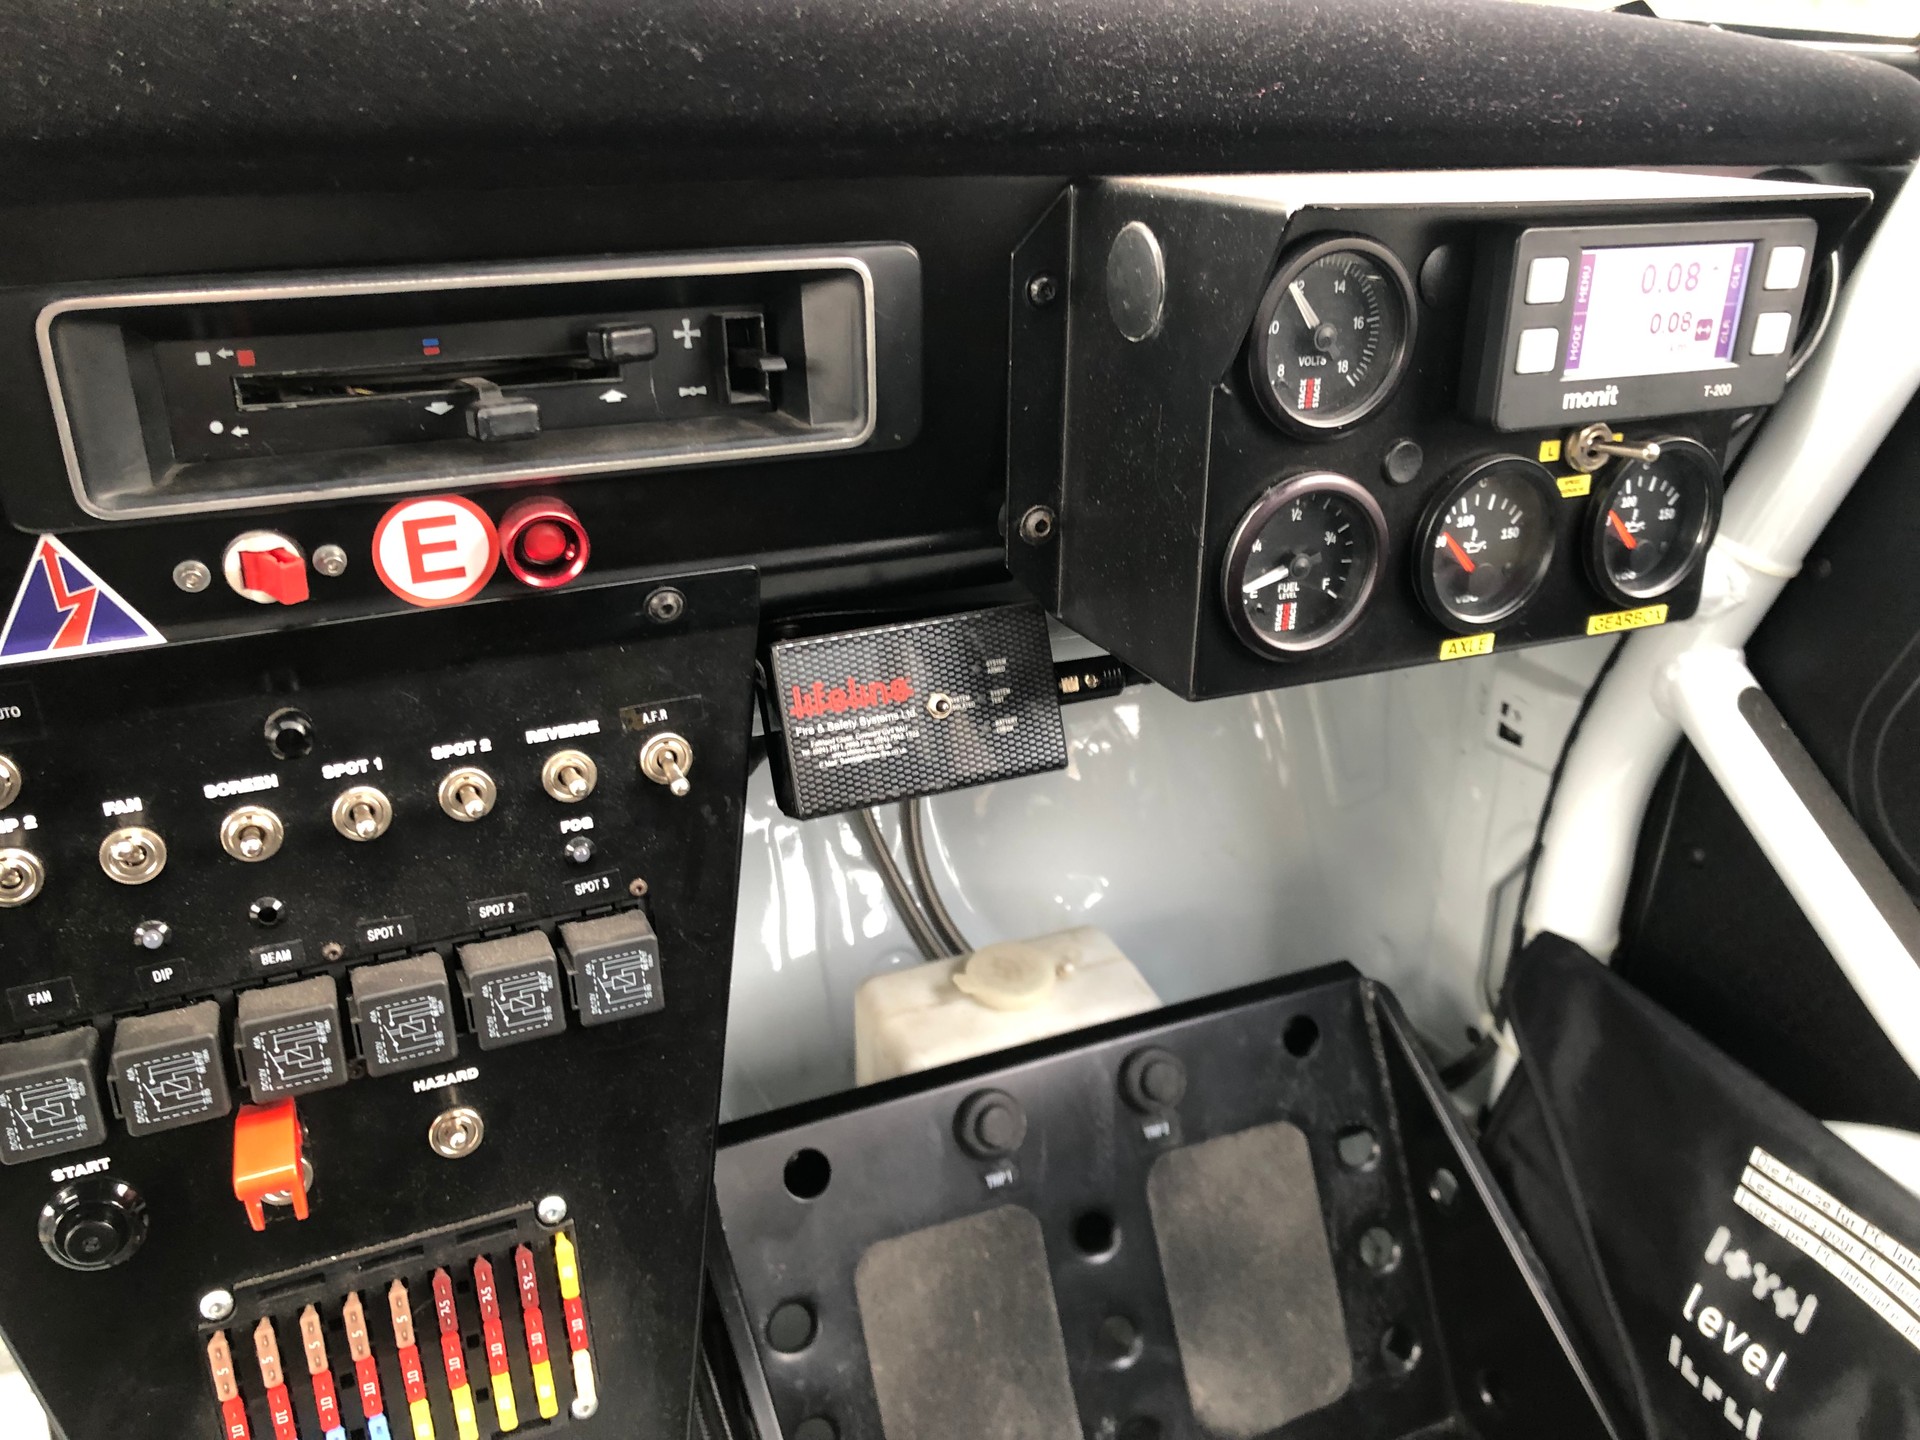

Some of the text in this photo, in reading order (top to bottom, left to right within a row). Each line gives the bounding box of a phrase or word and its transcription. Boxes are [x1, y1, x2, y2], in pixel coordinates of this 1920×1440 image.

[1334, 280, 1346, 293] 14
[1578, 265, 1592, 303] MENU
[1641, 262, 1701, 294] 0.08
[1353, 316, 1364, 330] 16
[1650, 311, 1692, 334] 0.08
[1569, 324, 1583, 361] MODE
[1299, 356, 1327, 367] VOLTS
[1337, 360, 1349, 373] 18
[1277, 364, 1285, 377] 8
[1298, 379, 1307, 409] STACK
[1312, 378, 1321, 408] STACK
[1562, 385, 1620, 410] monit
[1703, 384, 1733, 398] T-200
[1500, 527, 1520, 540] 150
[402, 515, 466, 584] E
[1277, 582, 1300, 593] FUEL
[1322, 578, 1330, 590] F
[1278, 592, 1297, 600] LEVEL
[1275, 603, 1283, 632] STACK
[1288, 602, 1297, 630] STACK
[1449, 634, 1487, 654] AXLE
[827, 719, 857, 731] Safety
[859, 712, 900, 727] Systems
[526, 720, 601, 745] REVERSE
[431, 738, 492, 761] SPOT 2
[322, 757, 383, 779] SPOT 1
[203, 773, 279, 799] SCREEN
[102, 797, 143, 817] FAN
[23, 814, 38, 830] 2
[560, 817, 594, 834] FOG
[574, 877, 610, 896] SPOT 3
[479, 902, 515, 919] SPOT 2
[367, 925, 403, 942] SPOT 1
[260, 949, 292, 966] BEAM
[152, 967, 173, 983] DIP
[28, 990, 53, 1006] FAN
[413, 1067, 479, 1093] HAZARD
[51, 1157, 111, 1183] START
[523, 1272, 534, 1290] 25
[481, 1286, 492, 1304] 25
[439, 1299, 451, 1317] 25
[397, 1314, 408, 1324] 5
[572, 1318, 583, 1333] 10
[351, 1330, 363, 1338] 5
[531, 1332, 543, 1346] 10
[1683, 1283, 1788, 1391] level
[309, 1341, 321, 1349] 5
[491, 1343, 503, 1357] 10
[262, 1355, 274, 1364] 5
[449, 1357, 461, 1371] 10
[216, 1368, 229, 1376] 5
[407, 1370, 419, 1384] 10
[363, 1382, 376, 1397] 10
[321, 1397, 333, 1411] 10
[275, 1410, 288, 1425] 10
[232, 1424, 245, 1439] 10
